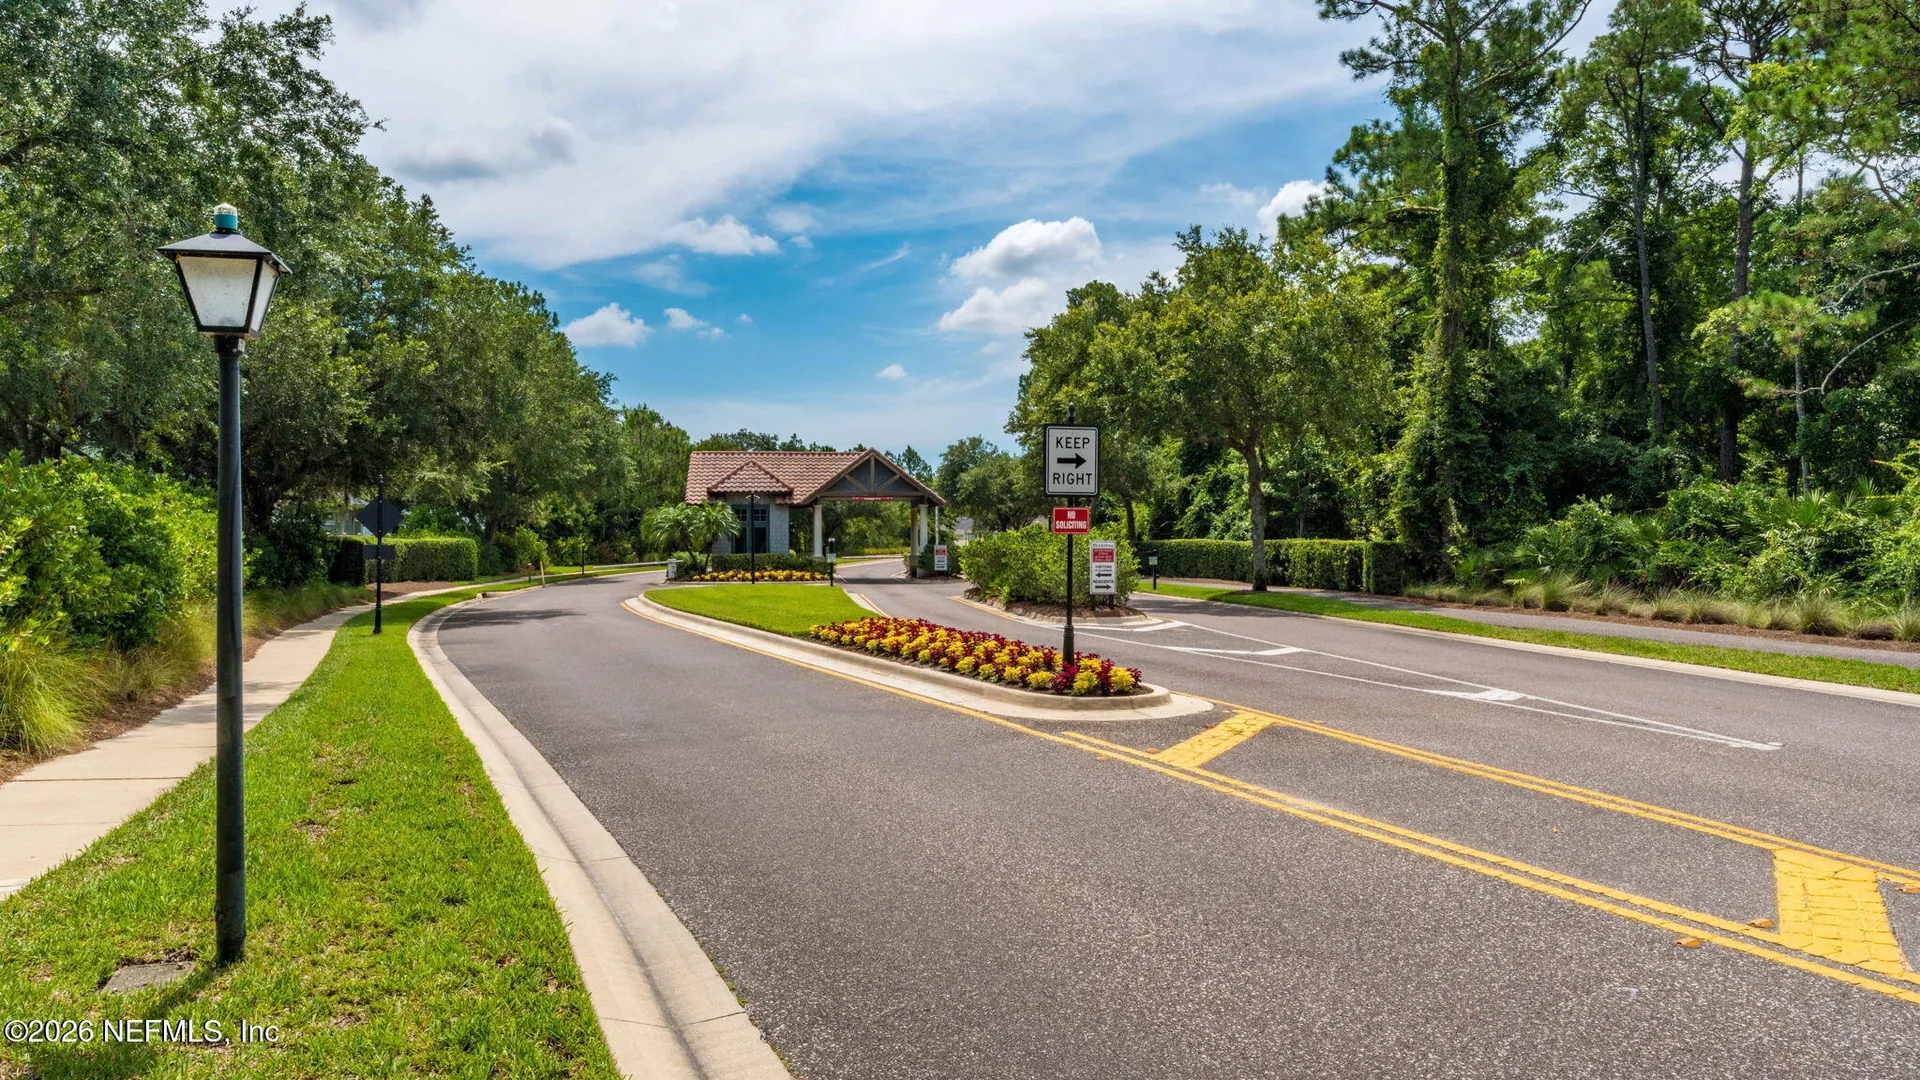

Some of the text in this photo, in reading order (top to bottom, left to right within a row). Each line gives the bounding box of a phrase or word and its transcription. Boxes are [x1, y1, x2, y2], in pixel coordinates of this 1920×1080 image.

[1055, 436, 1091, 449] KEEP
[1053, 472, 1093, 485] RIGHT
[1067, 510, 1076, 519] NO
[1055, 520, 1087, 529] SOLICITING
